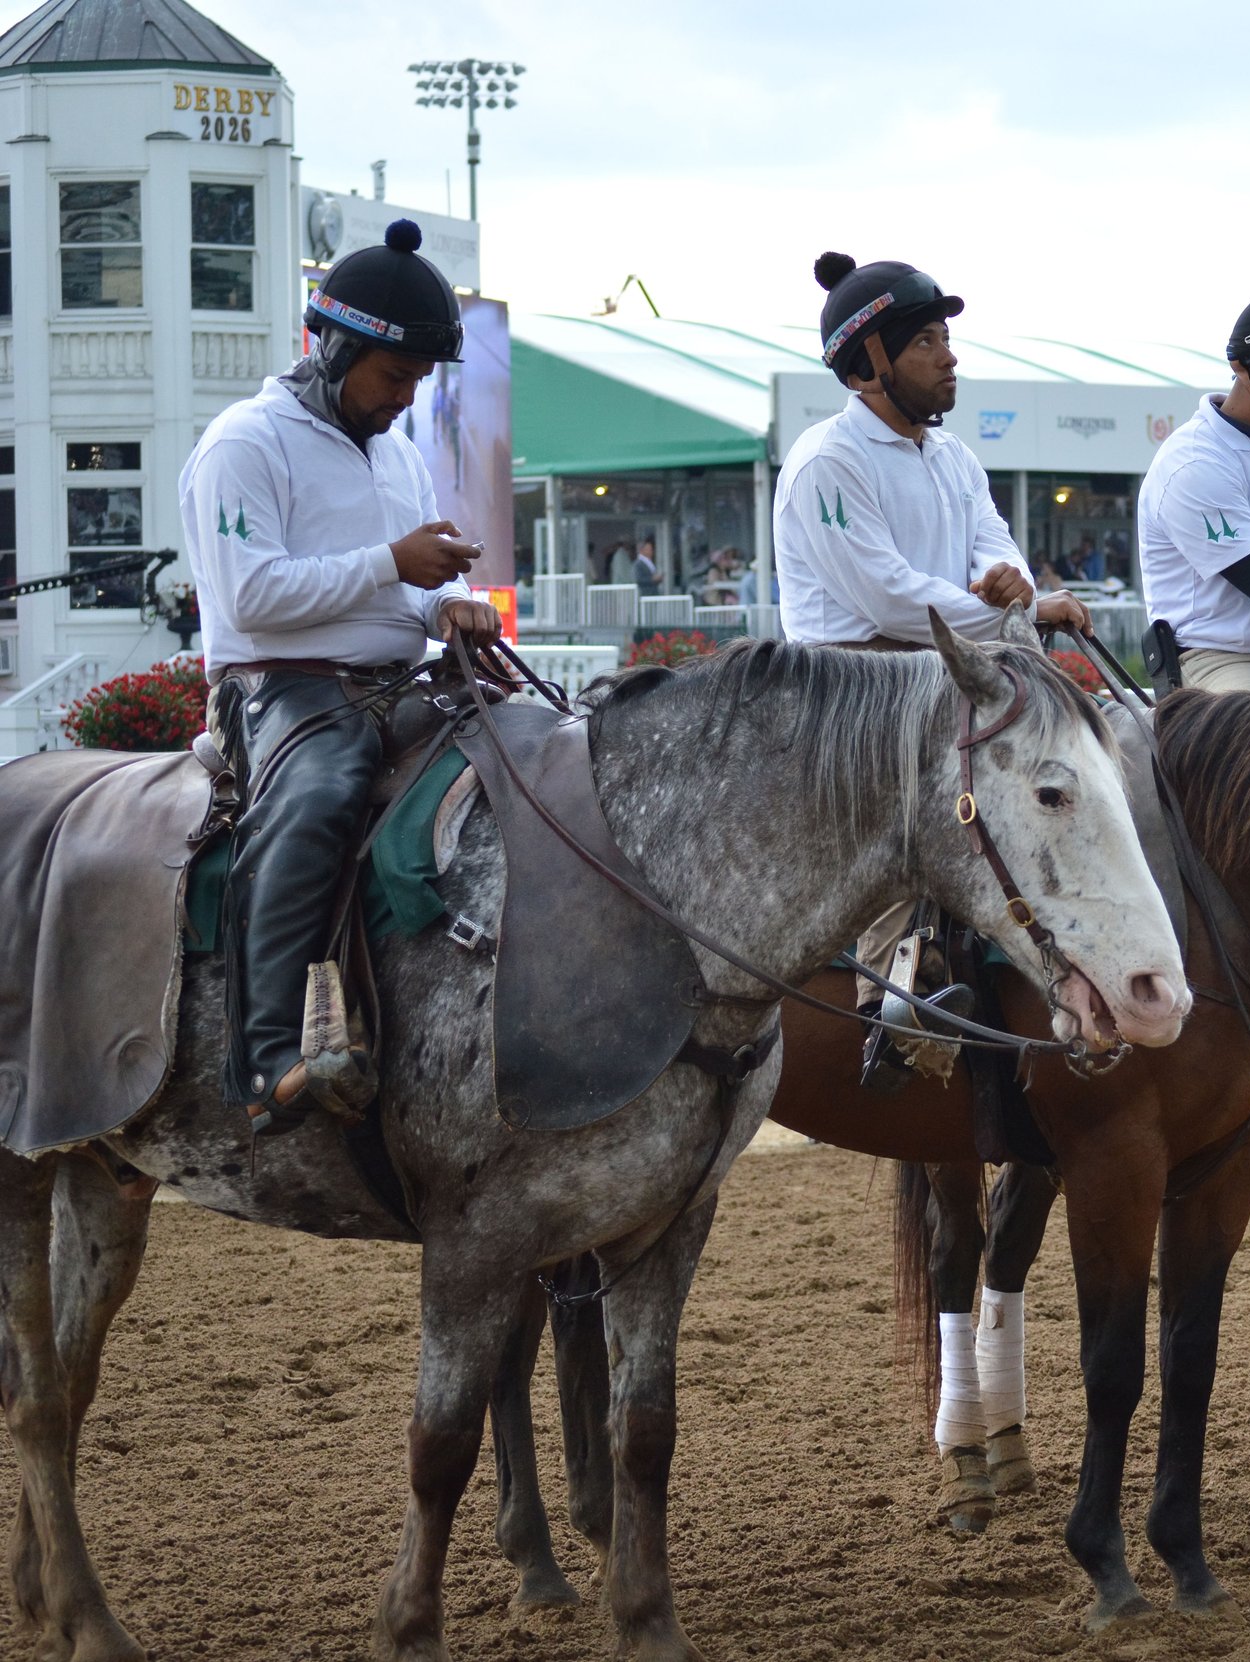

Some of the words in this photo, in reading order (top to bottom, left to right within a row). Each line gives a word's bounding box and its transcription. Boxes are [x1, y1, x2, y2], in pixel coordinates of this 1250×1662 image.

[174, 84, 276, 116] DERBY
[200, 115, 251, 142] 2026
[1056, 414, 1116, 431] LONGINES
